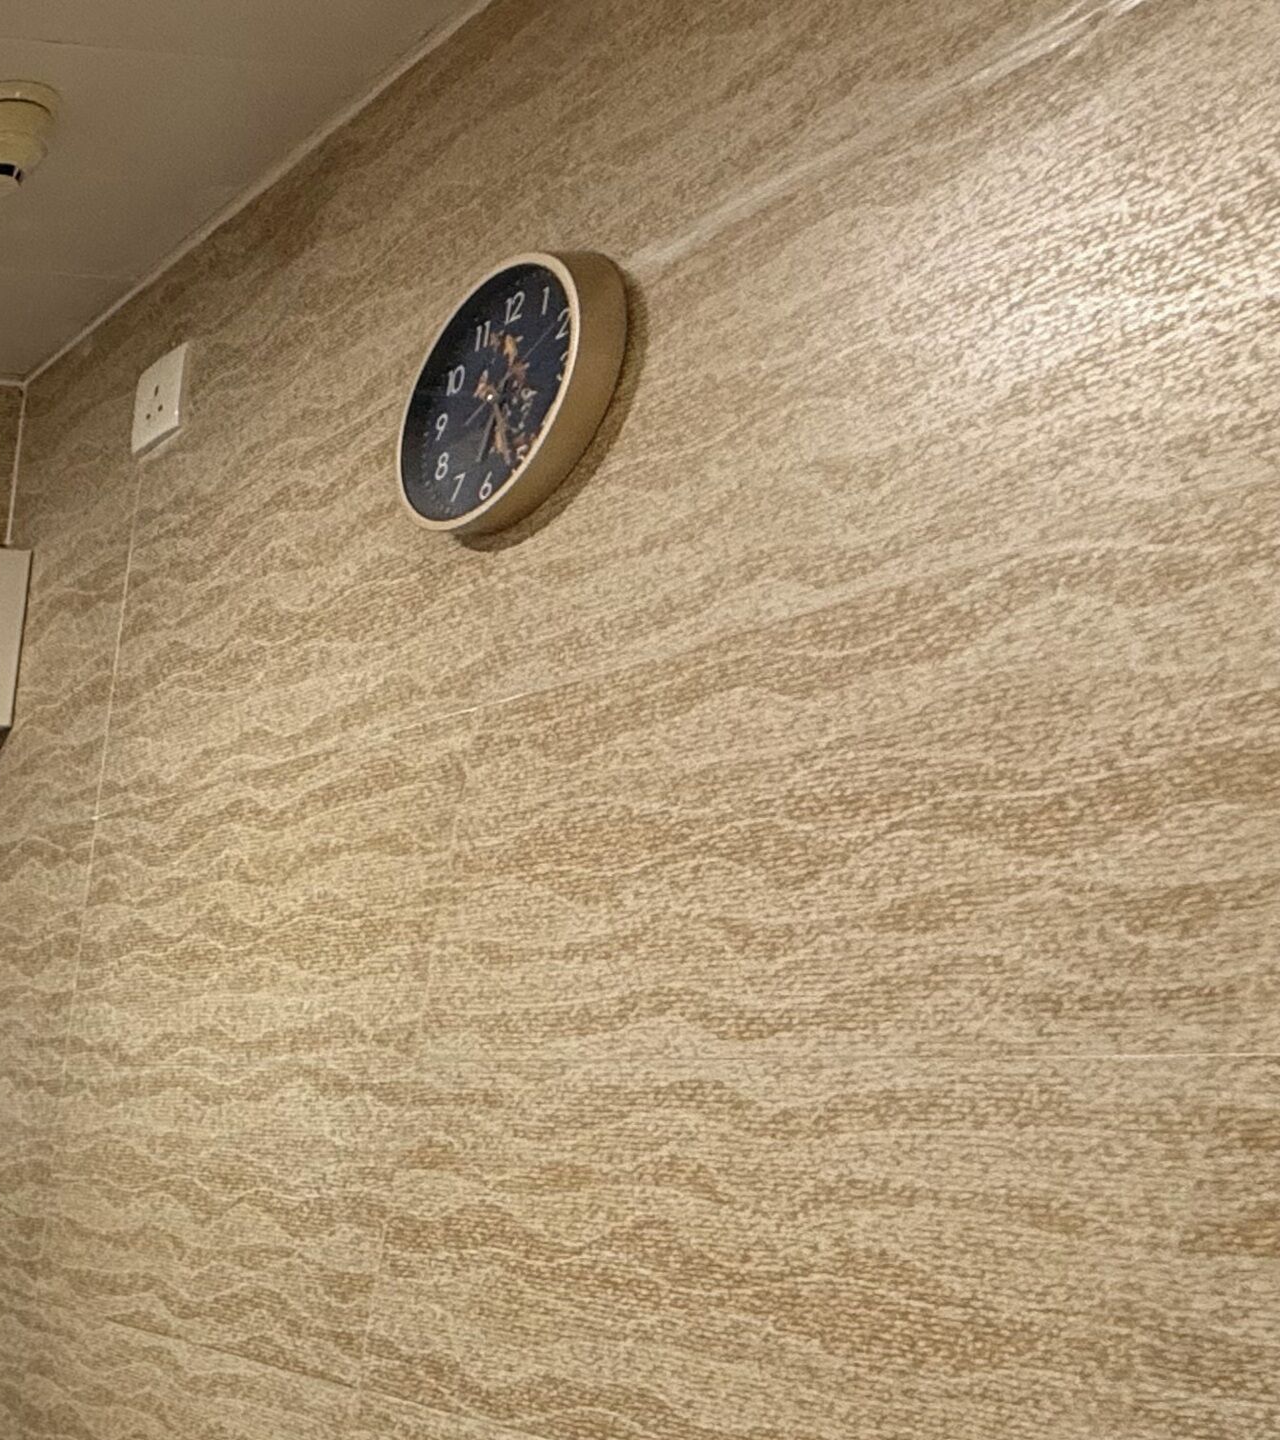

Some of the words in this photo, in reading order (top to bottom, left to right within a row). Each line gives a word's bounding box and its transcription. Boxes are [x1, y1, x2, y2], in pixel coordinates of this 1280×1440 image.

[505, 291, 525, 325] 12
[542, 287, 550, 315] 1
[475, 321, 491, 352] 11
[555, 308, 570, 340] 2
[446, 365, 466, 397] 10
[435, 413, 449, 441] 9
[435, 452, 449, 481] 8
[451, 472, 466, 502] 7
[479, 471, 493, 500] 6
